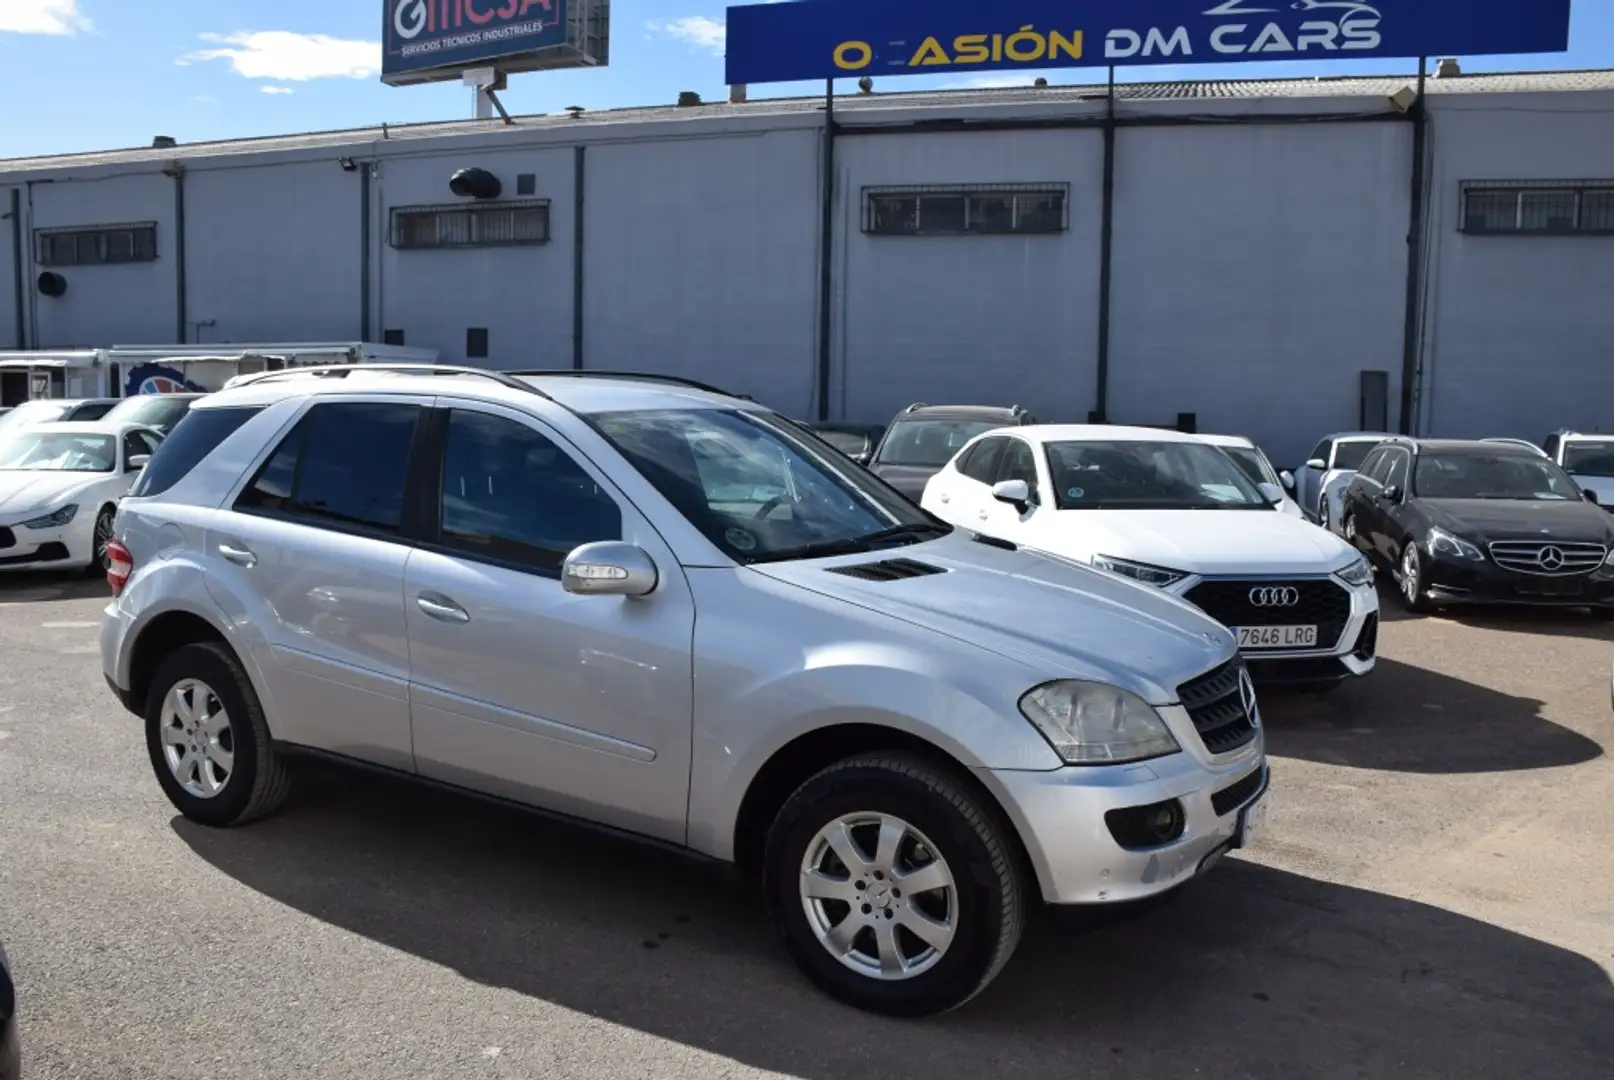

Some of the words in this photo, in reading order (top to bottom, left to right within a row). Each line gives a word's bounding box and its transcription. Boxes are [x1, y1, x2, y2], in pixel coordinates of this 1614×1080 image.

[833, 24, 1083, 70] OASIÓN
[1105, 26, 1193, 58] DM
[1209, 18, 1382, 54] CARS
[1240, 628, 1279, 645] 7646
[1285, 627, 1314, 643] LRG
